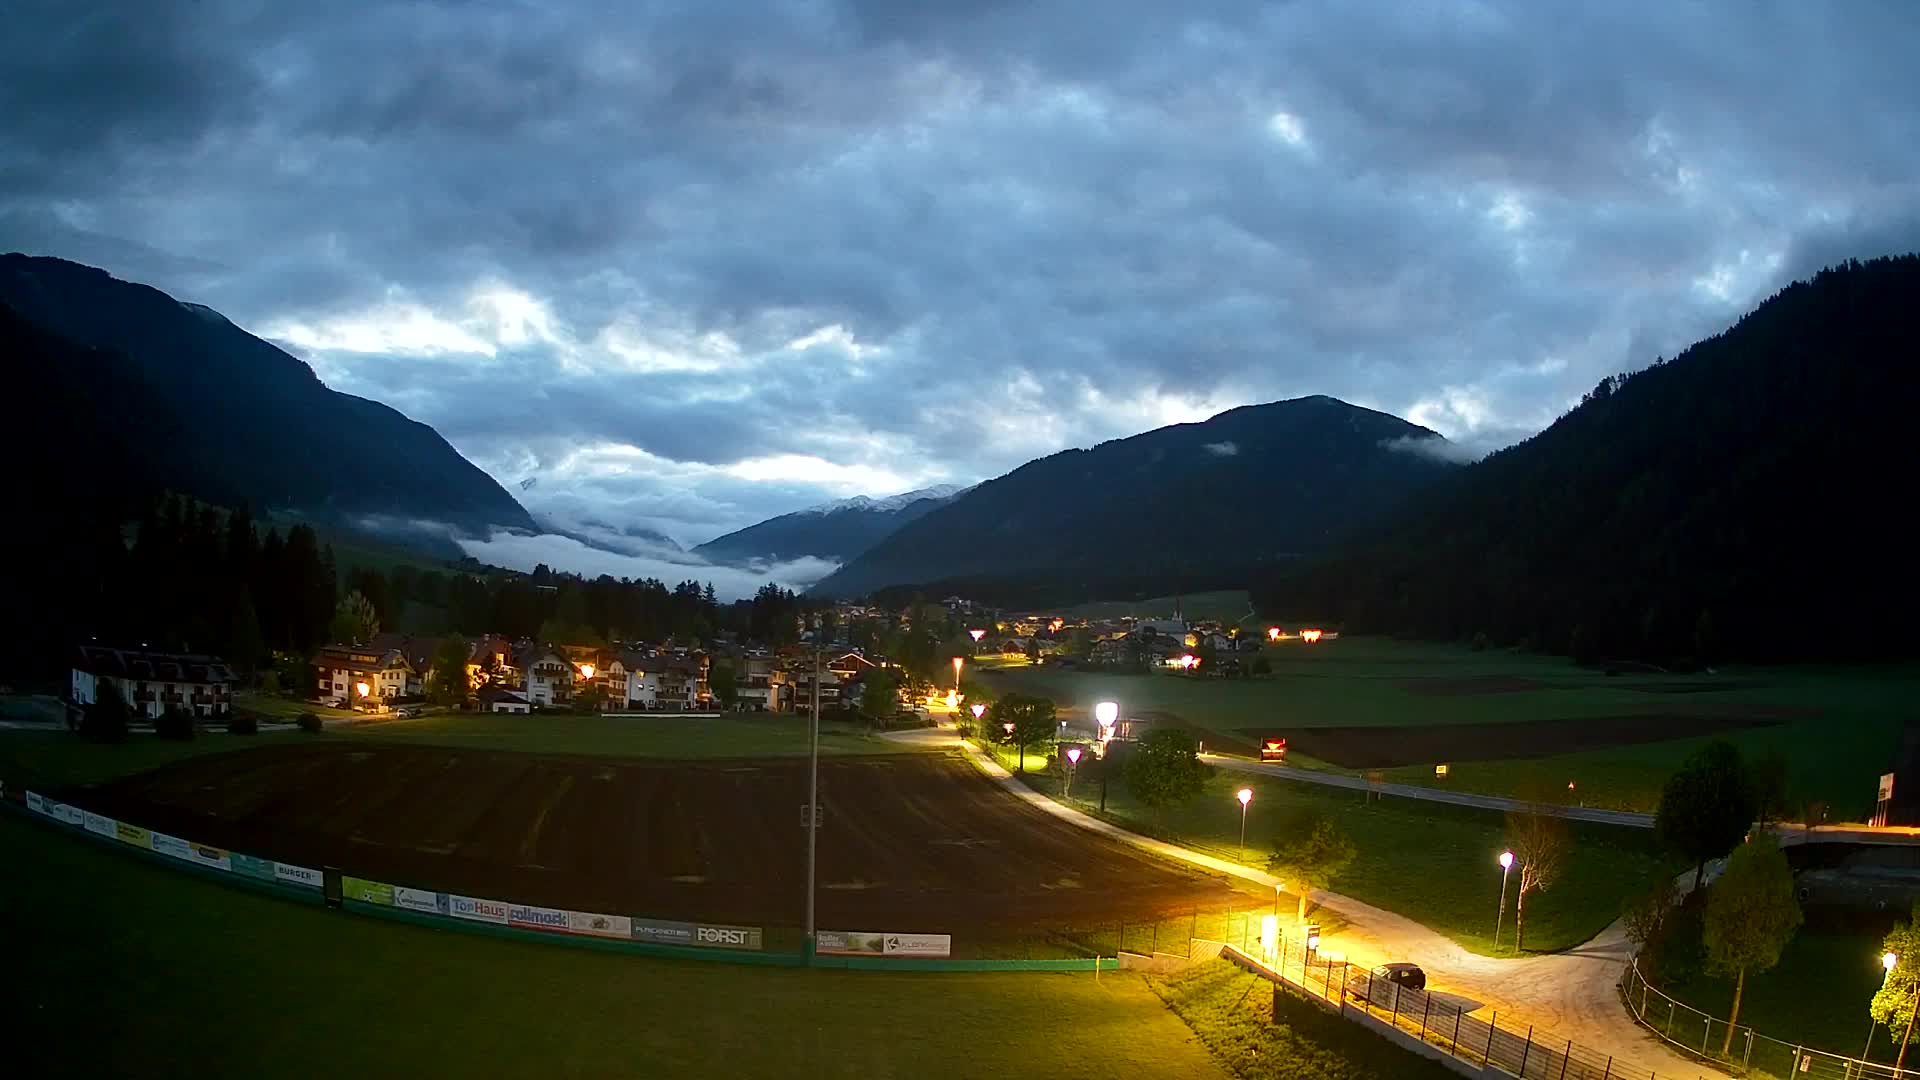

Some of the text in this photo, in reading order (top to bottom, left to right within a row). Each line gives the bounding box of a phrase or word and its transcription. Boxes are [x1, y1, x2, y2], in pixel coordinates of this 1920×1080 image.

[279, 867, 311, 880] BURGER
[455, 901, 505, 917] TopHaus
[697, 927, 748, 944] FORST
